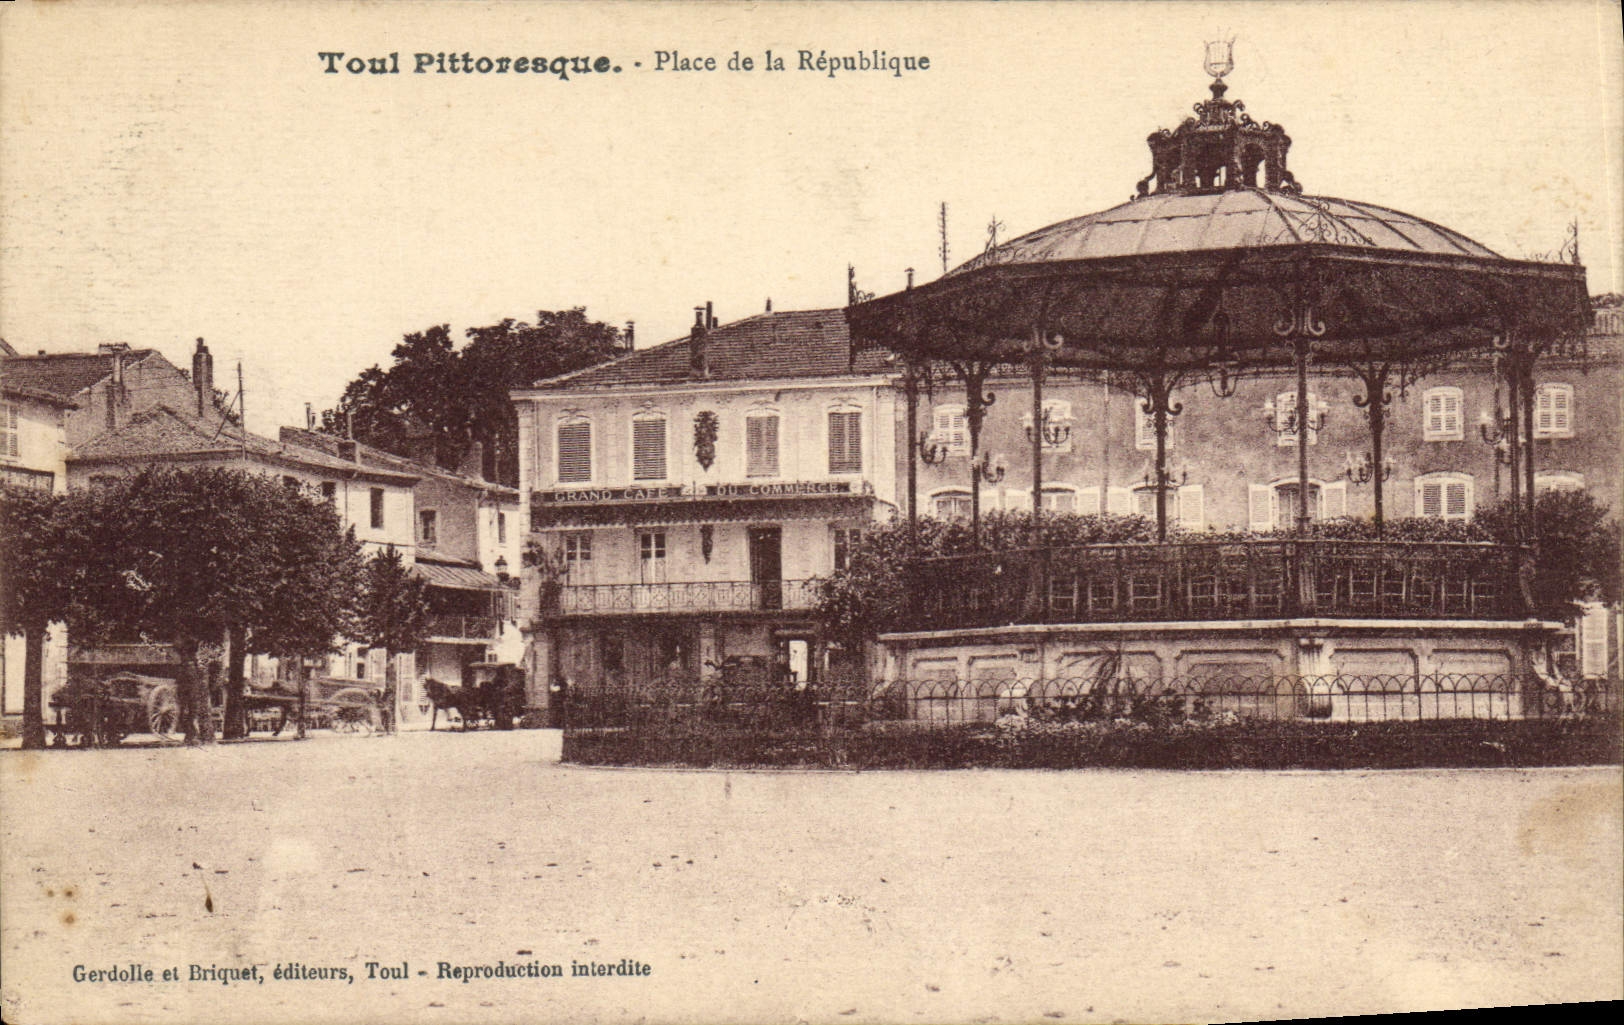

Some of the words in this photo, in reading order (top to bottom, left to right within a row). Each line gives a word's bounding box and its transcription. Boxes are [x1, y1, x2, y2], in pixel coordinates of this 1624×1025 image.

[555, 489, 613, 501] GRAND
[717, 485, 738, 496] DU
[750, 482, 839, 495] COMMERCE
